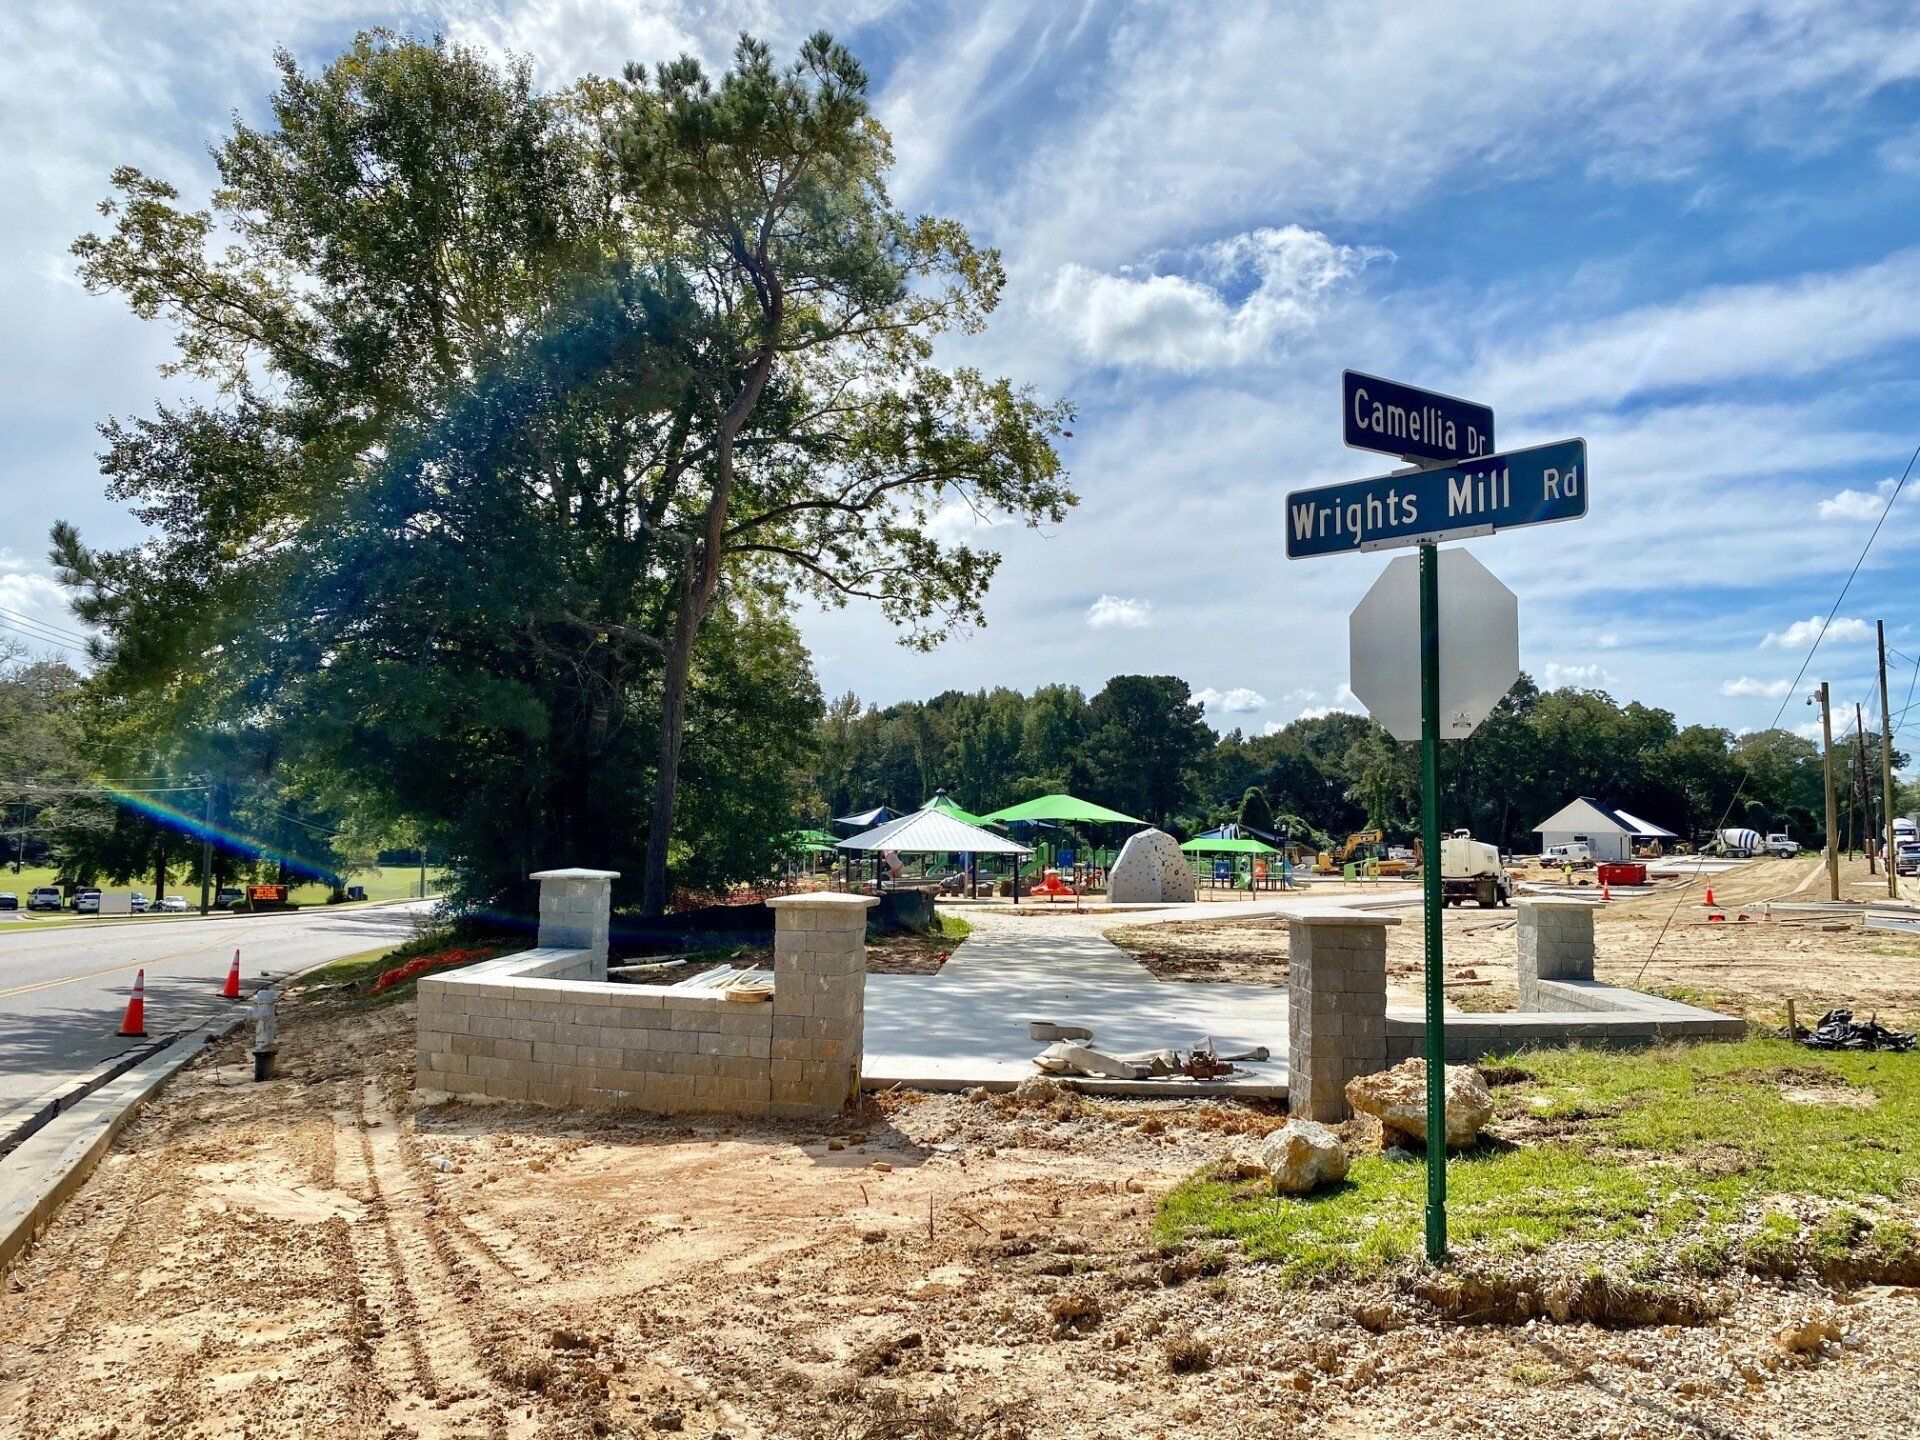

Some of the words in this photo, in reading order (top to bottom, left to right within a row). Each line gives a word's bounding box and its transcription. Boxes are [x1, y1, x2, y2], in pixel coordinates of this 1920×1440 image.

[1354, 388, 1456, 450] Camellia
[1467, 426, 1486, 456] Dr
[1292, 488, 1418, 544] Wrights
[1448, 467, 1510, 517] Mill
[1543, 465, 1577, 501] Rd
